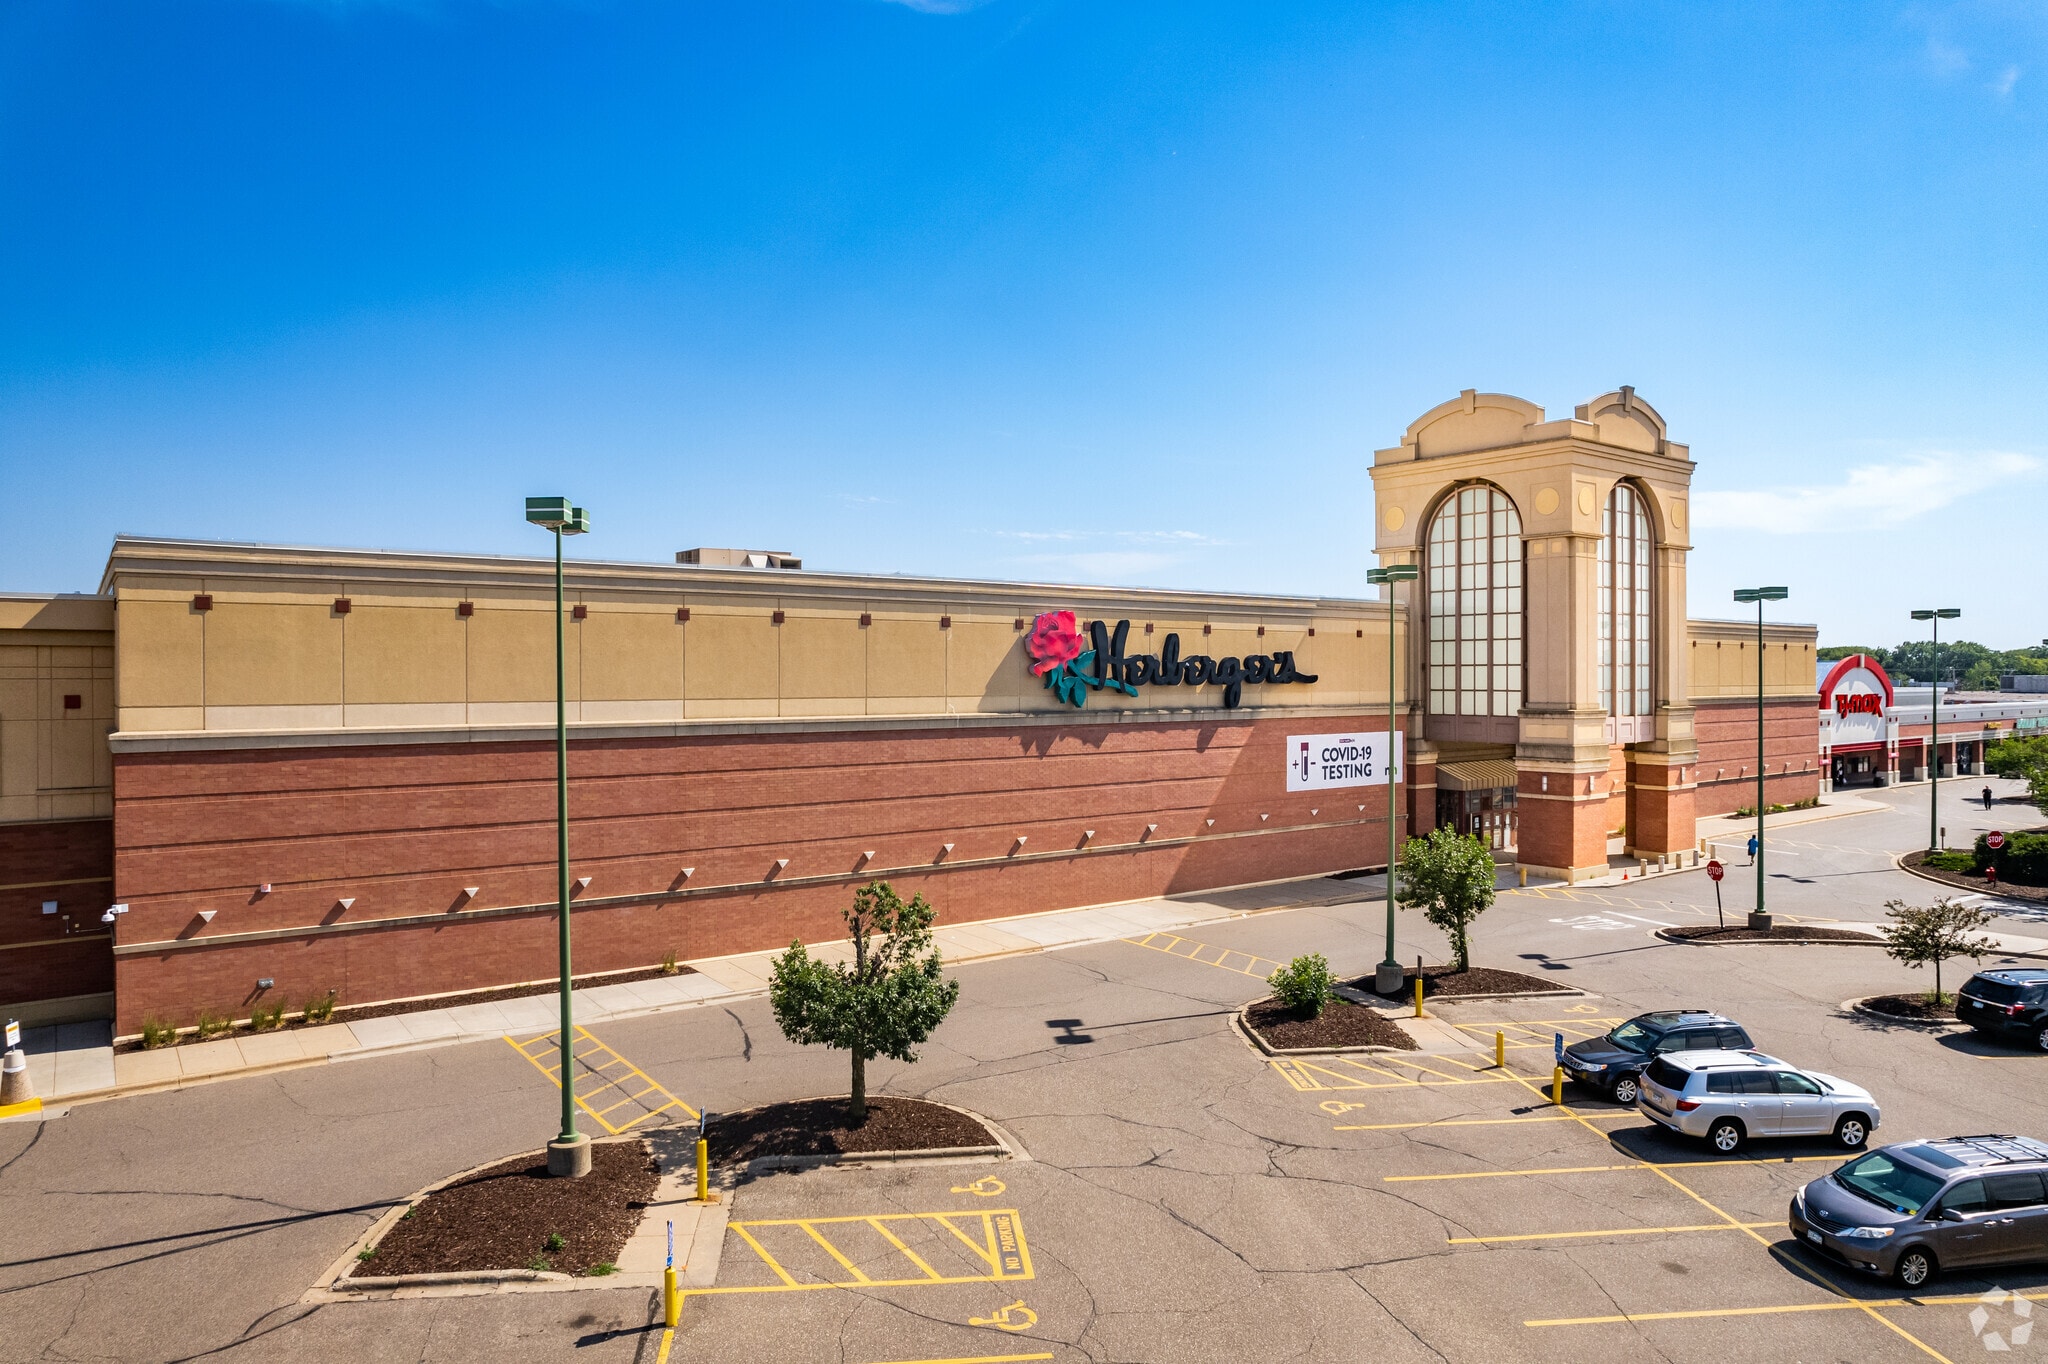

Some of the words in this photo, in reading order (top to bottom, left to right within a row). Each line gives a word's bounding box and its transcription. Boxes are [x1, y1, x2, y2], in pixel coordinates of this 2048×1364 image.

[1091, 620, 1318, 708] Herberger's
[1322, 746, 1372, 762] COVID-19
[1322, 763, 1372, 780] TESTING
[1708, 866, 1722, 875] STOP
[995, 1216, 1016, 1252] PARKING
[1005, 1257, 1020, 1270] NO
